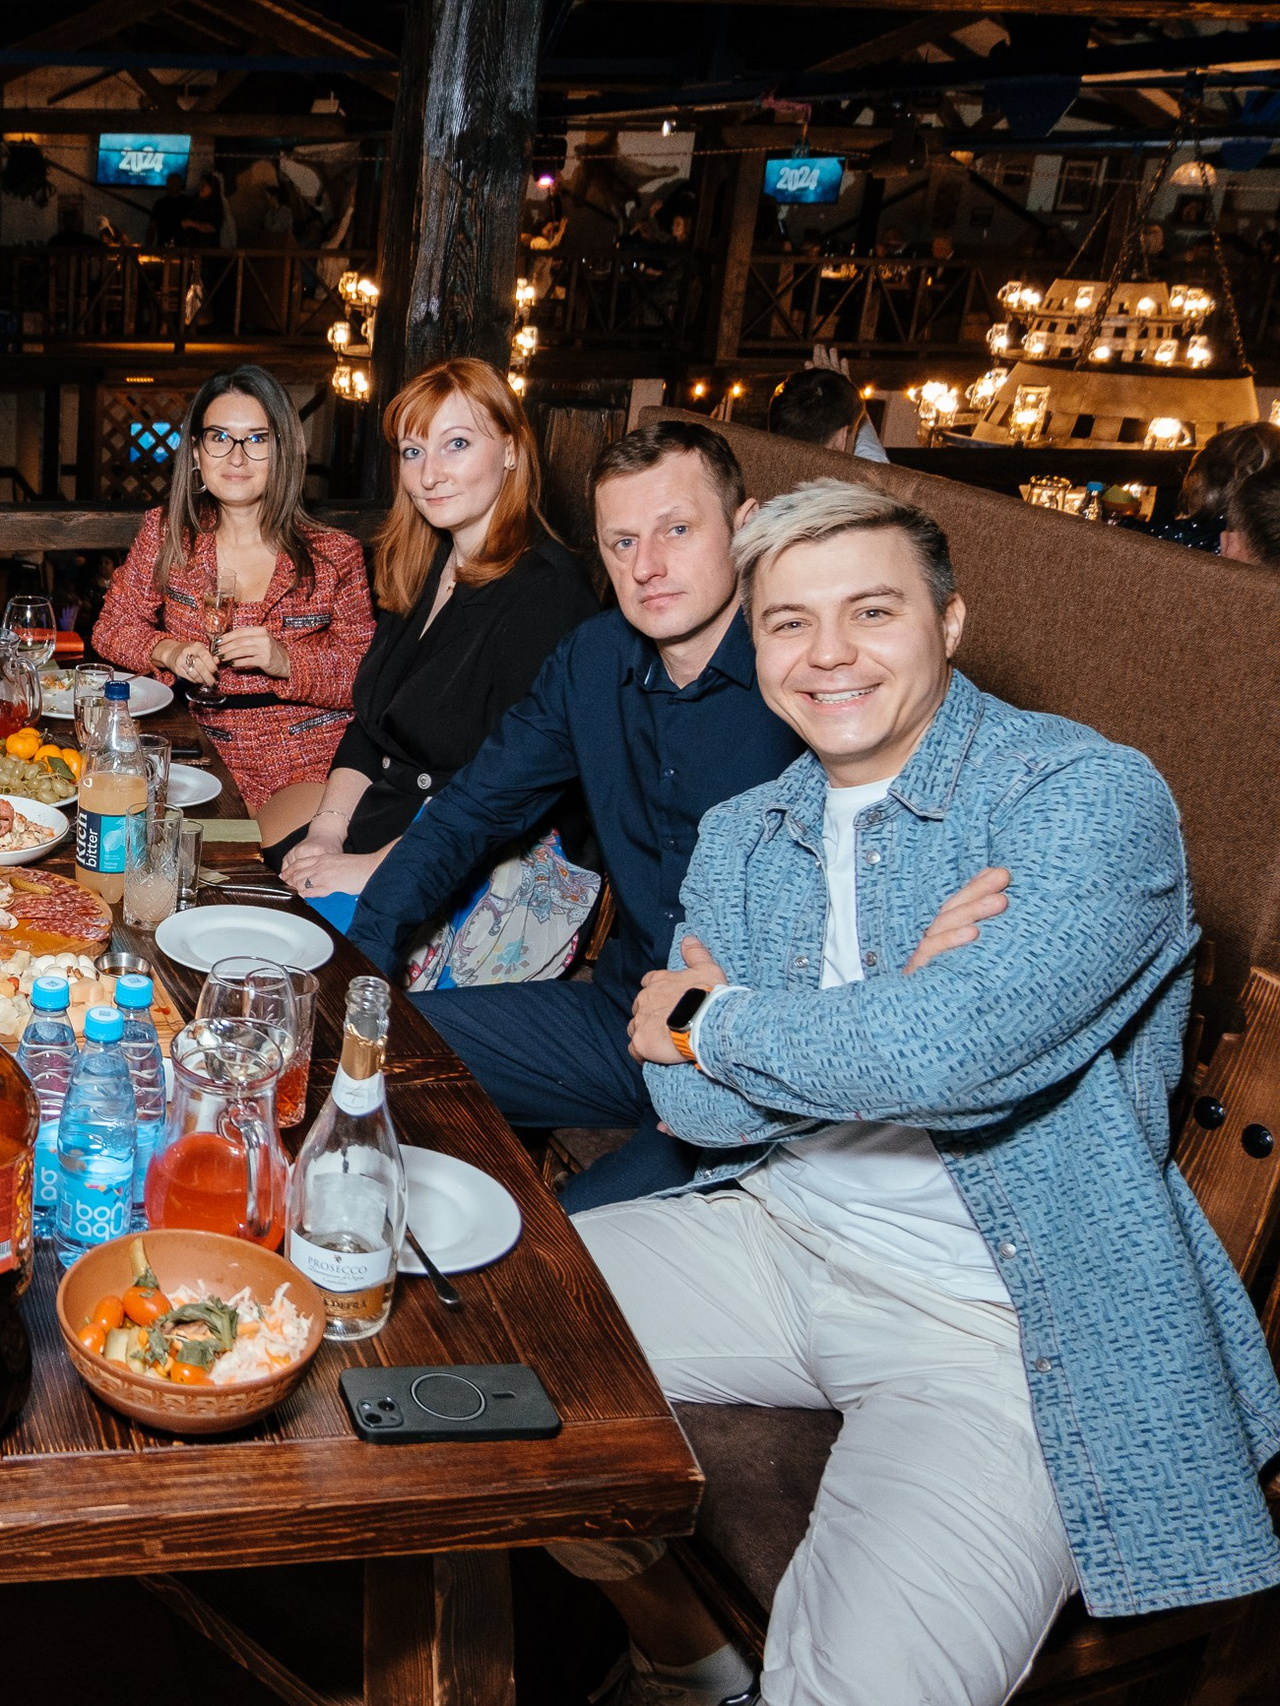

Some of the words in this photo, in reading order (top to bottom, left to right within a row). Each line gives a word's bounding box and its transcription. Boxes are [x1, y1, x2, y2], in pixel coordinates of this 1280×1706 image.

[776, 166, 820, 191] 2024
[85, 828, 99, 868] bitter
[75, 1219, 124, 1241] aqu
[307, 1255, 367, 1275] PROSECCO
